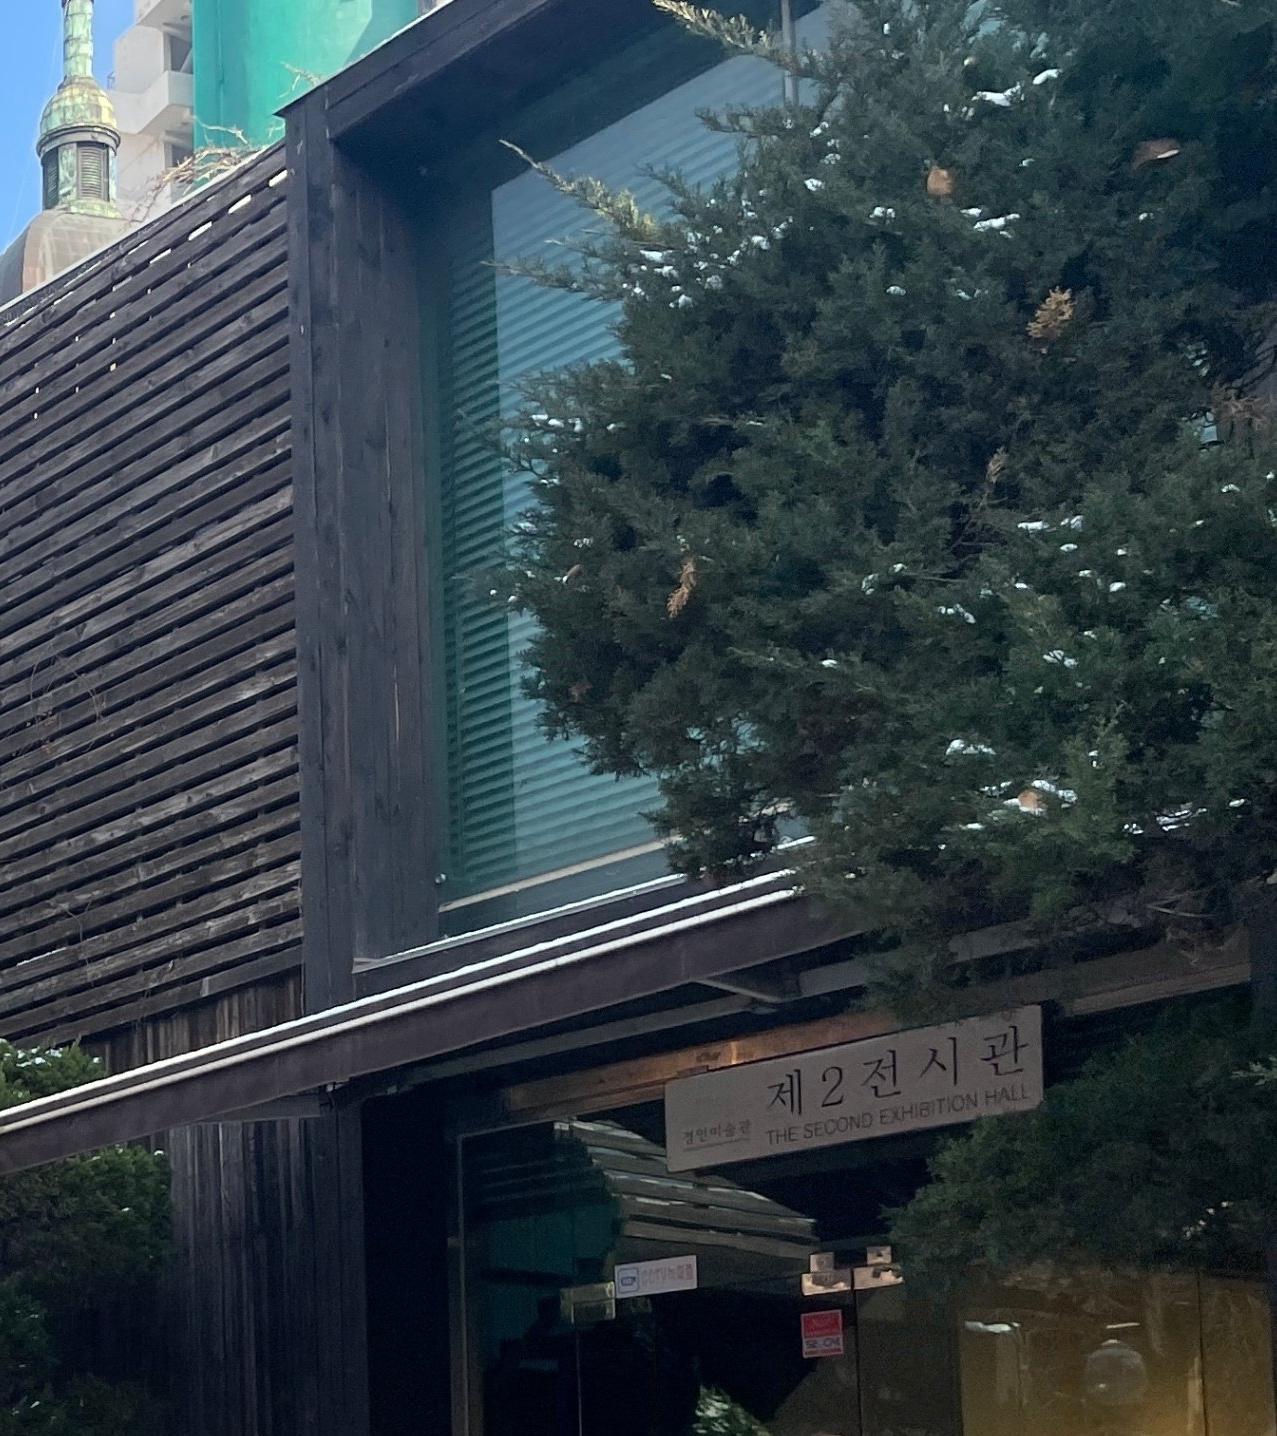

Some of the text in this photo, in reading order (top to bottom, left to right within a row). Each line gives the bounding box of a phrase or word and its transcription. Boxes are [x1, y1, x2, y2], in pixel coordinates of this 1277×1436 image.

[765, 1084, 1030, 1146] THE SECOND EXHIBITION HALL
